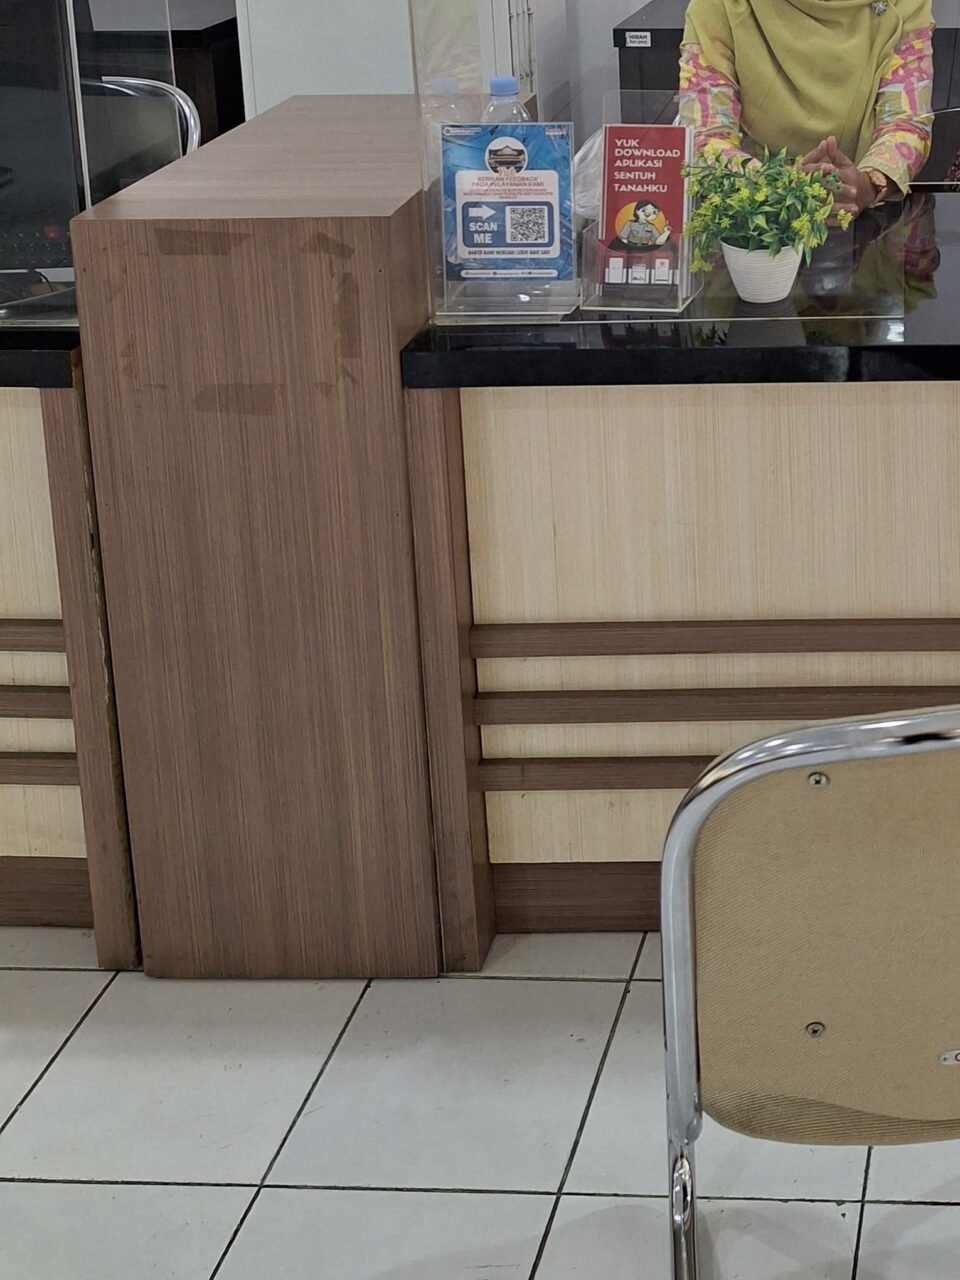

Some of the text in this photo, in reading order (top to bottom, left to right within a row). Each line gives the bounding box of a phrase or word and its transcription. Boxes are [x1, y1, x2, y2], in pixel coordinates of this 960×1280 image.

[615, 139, 640, 147] YUK
[614, 148, 681, 157] DOWNLOAD
[614, 159, 663, 168] APLIKASI
[614, 171, 656, 180] SENTUH
[614, 183, 668, 193] TANAHKU
[469, 222, 498, 232] SCAN
[473, 233, 493, 244] ME
